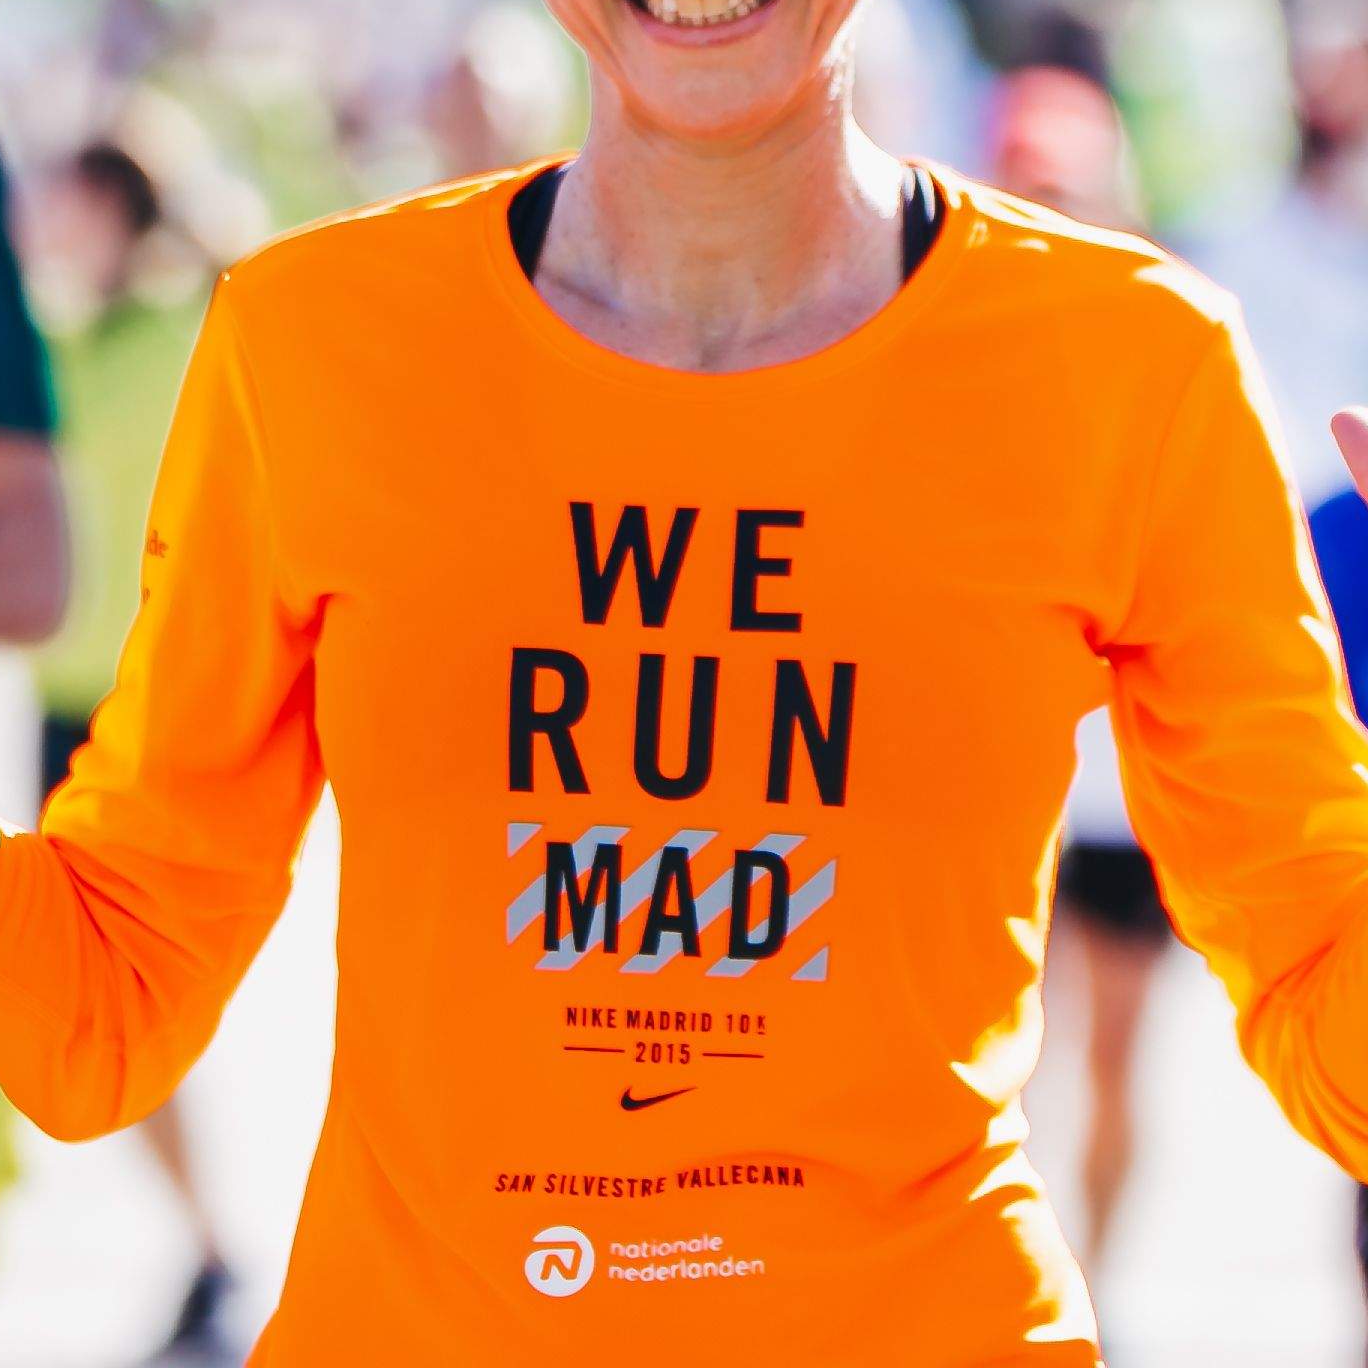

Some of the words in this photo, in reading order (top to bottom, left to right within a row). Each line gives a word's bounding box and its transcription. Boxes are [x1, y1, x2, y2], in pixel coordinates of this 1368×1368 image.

[569, 501, 805, 633] WE
[508, 646, 858, 807] RUN
[543, 840, 791, 961] MAD
[566, 1006, 617, 1029] NIKE
[626, 1009, 712, 1032] MADRID
[635, 1041, 691, 1065] 2015
[495, 1173, 536, 1193] SAN
[544, 1173, 667, 1198] SILVESTRE
[677, 1164, 805, 1189] VALLECANA
[609, 1232, 723, 1260] nationale
[608, 1256, 765, 1283] nederlanden
